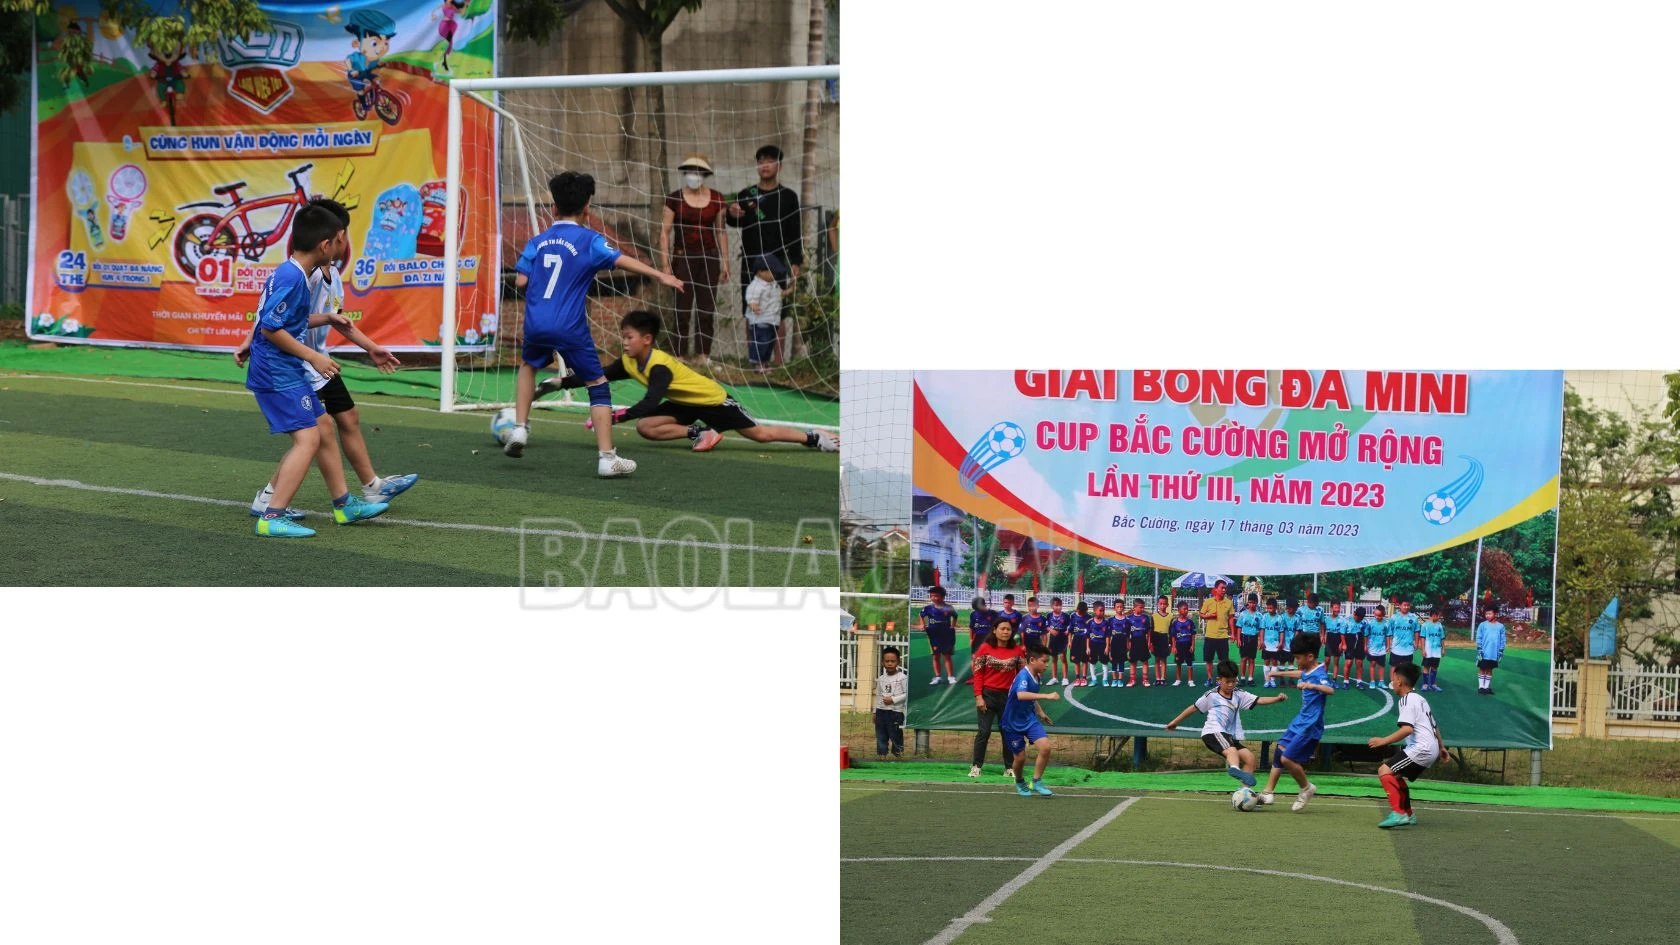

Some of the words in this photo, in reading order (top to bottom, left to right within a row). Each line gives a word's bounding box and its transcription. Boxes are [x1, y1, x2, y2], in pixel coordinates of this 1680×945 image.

[149, 133, 188, 150] CÙNG
[190, 136, 221, 150] KUN
[223, 133, 256, 152] VẬN
[258, 131, 299, 152] ĐỘNG
[302, 127, 330, 148] MỖI
[332, 129, 373, 147] NGÀY
[60, 251, 87, 270] 24
[198, 256, 231, 284] 01
[354, 258, 376, 276] 36
[398, 260, 428, 272] BALO
[256, 268, 267, 277] 01
[403, 274, 419, 283] ĐA
[422, 273, 432, 282] ZI
[543, 253, 563, 299] 7
[171, 311, 192, 320] GIAN
[1364, 370, 1468, 415] MINI
[1036, 420, 1099, 452] CUP
[1109, 413, 1172, 455] BẮC
[1182, 420, 1289, 459] CƯỜNG
[1298, 422, 1350, 462] MỞ
[1357, 428, 1443, 470] RỘNG
[1087, 464, 1140, 498] LẦN
[1148, 470, 1202, 501] THỨ
[1207, 476, 1241, 505] III,
[1250, 473, 1313, 505] NĂM
[1320, 481, 1385, 508] 2023
[1111, 514, 1136, 528] Bắc
[1185, 518, 1215, 534] ngày
[1221, 519, 1236, 532] 17
[1239, 520, 1275, 536] tháng
[1278, 521, 1294, 534] 03
[1298, 522, 1325, 536] năm
[1328, 523, 1360, 537] 2023
